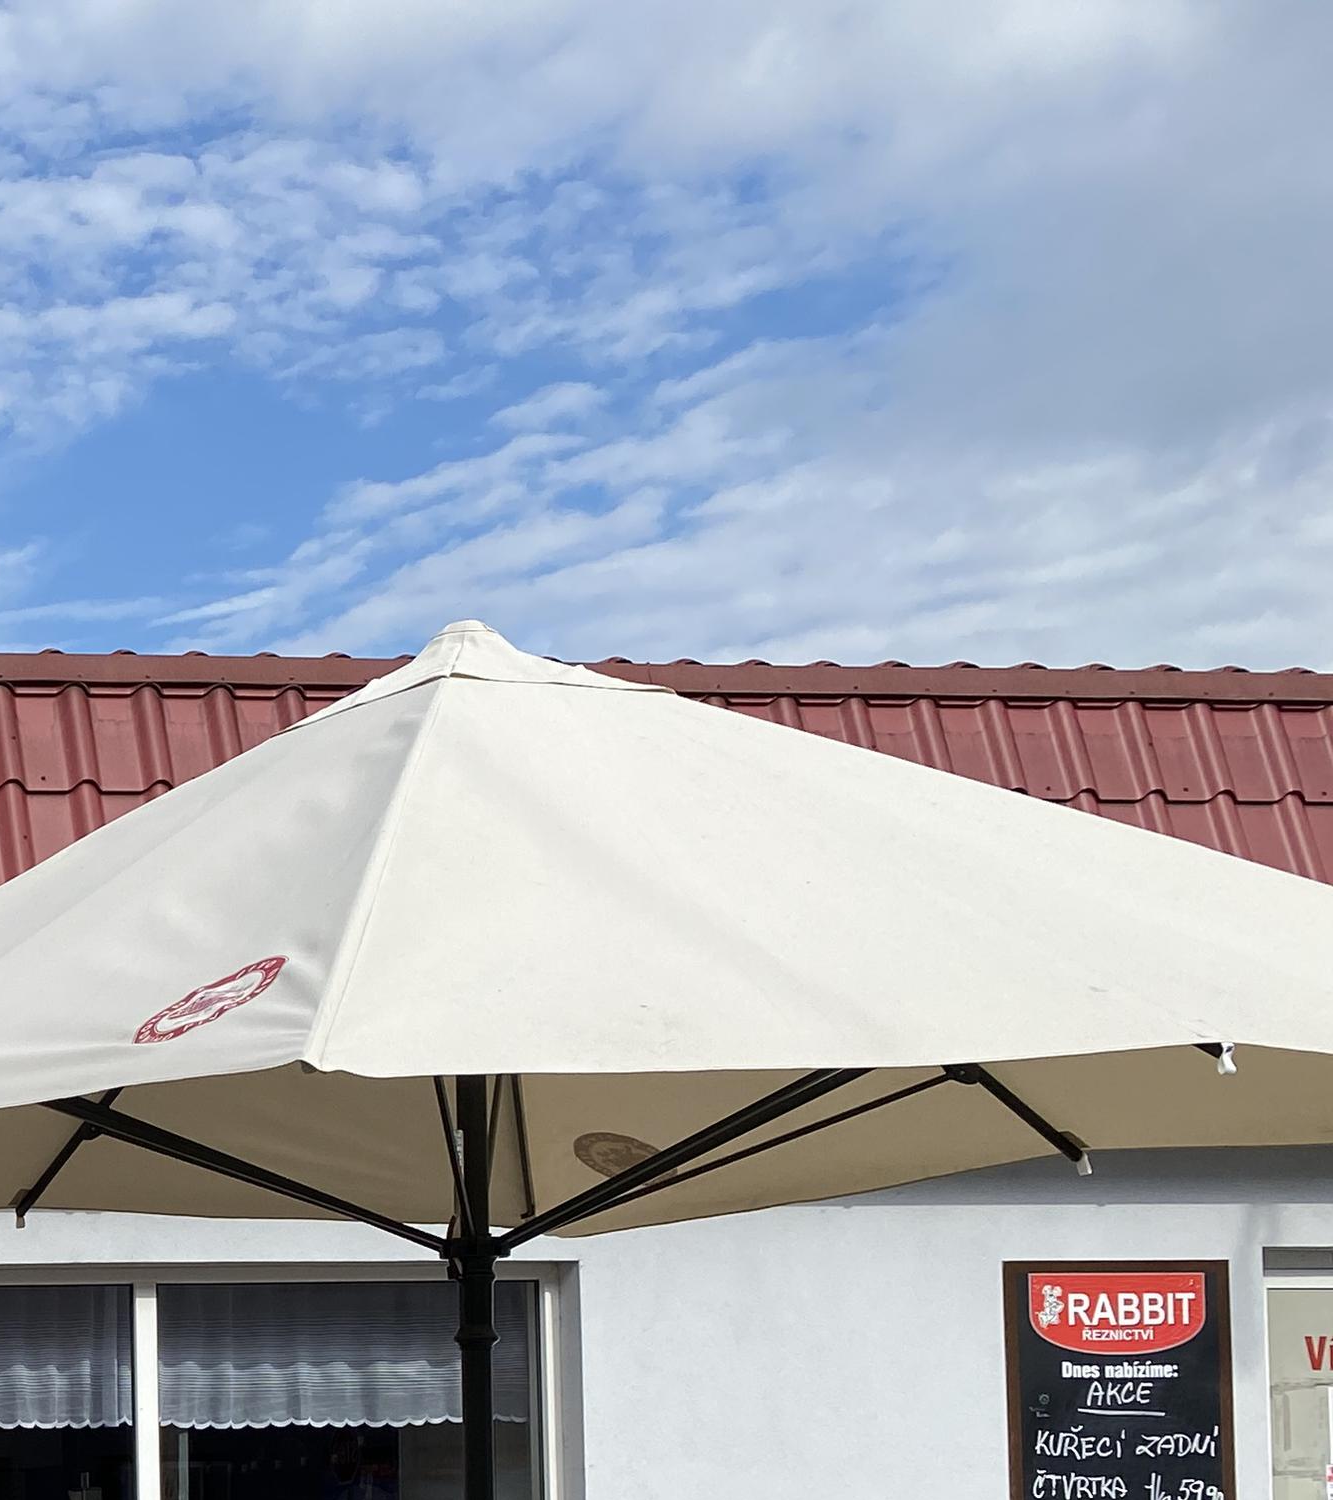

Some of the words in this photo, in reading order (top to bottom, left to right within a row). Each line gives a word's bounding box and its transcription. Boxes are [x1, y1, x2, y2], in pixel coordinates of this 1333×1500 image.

[1067, 1292, 1196, 1326] RABBIT
[1082, 1327, 1154, 1341] ŘEZNICTVÍ
[1061, 1361, 1100, 1378] Dnes
[1105, 1360, 1179, 1378] nabízíme:
[1086, 1381, 1154, 1406] AKCE
